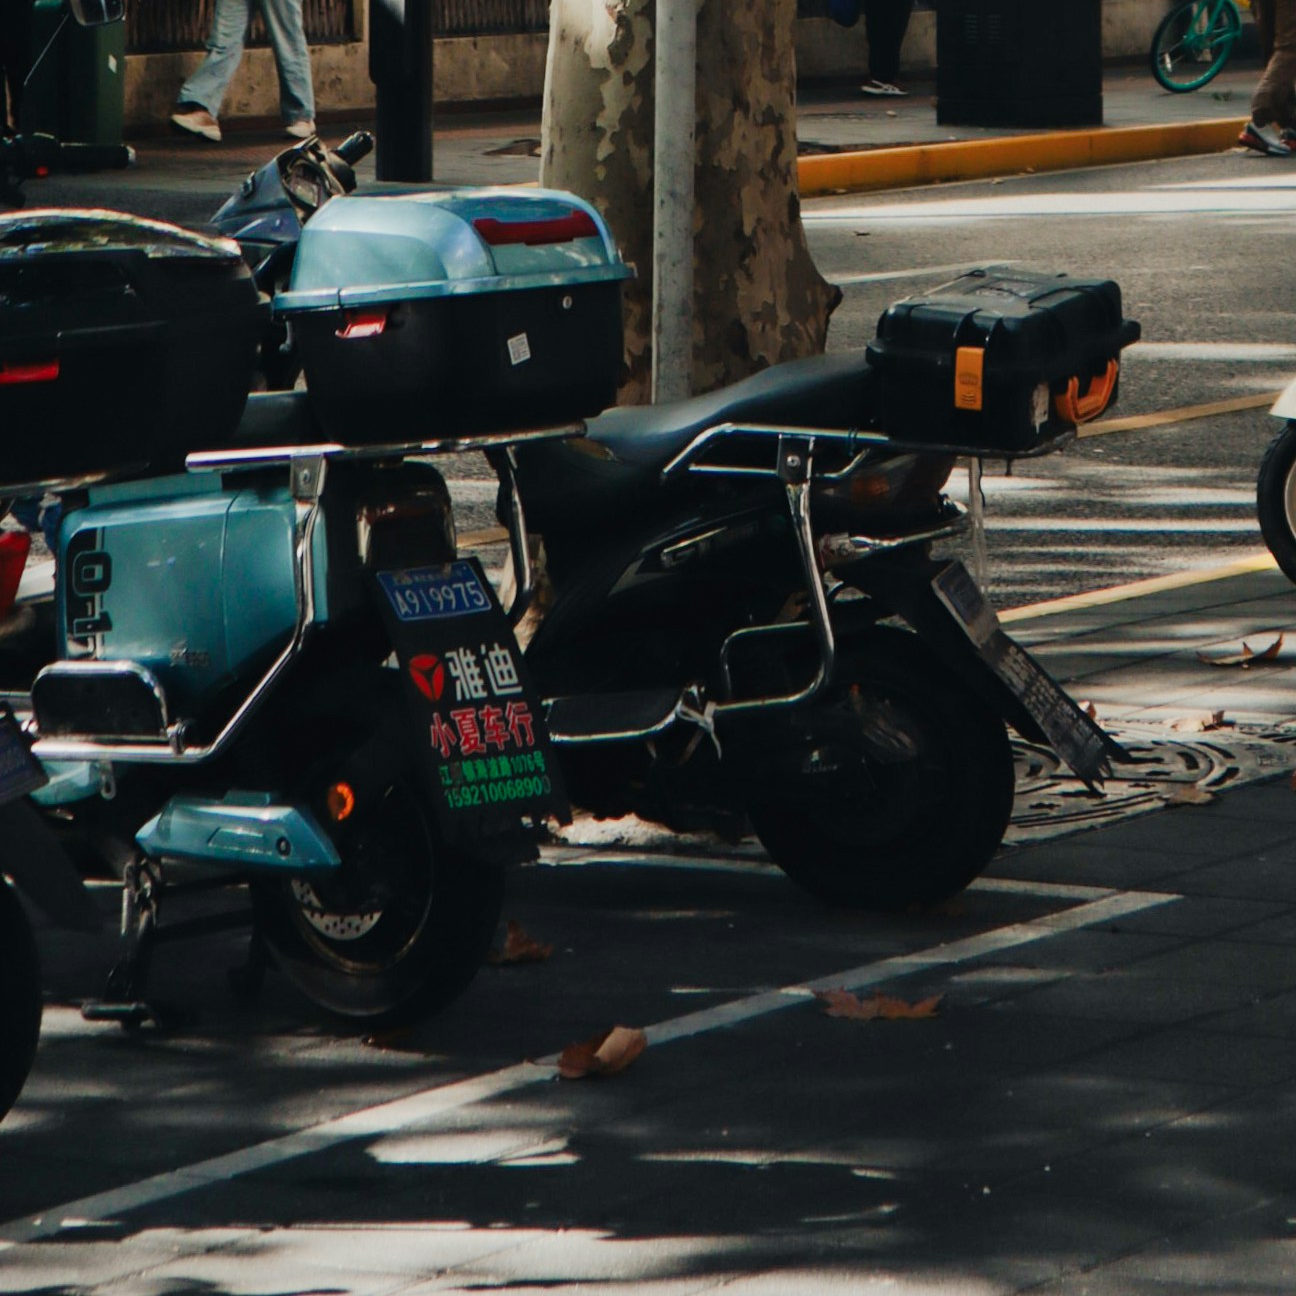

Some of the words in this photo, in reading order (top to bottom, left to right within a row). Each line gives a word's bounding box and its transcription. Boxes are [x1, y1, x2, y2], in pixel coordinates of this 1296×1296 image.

[445, 642, 523, 702] 雅迪
[430, 701, 536, 758] 小夏车行
